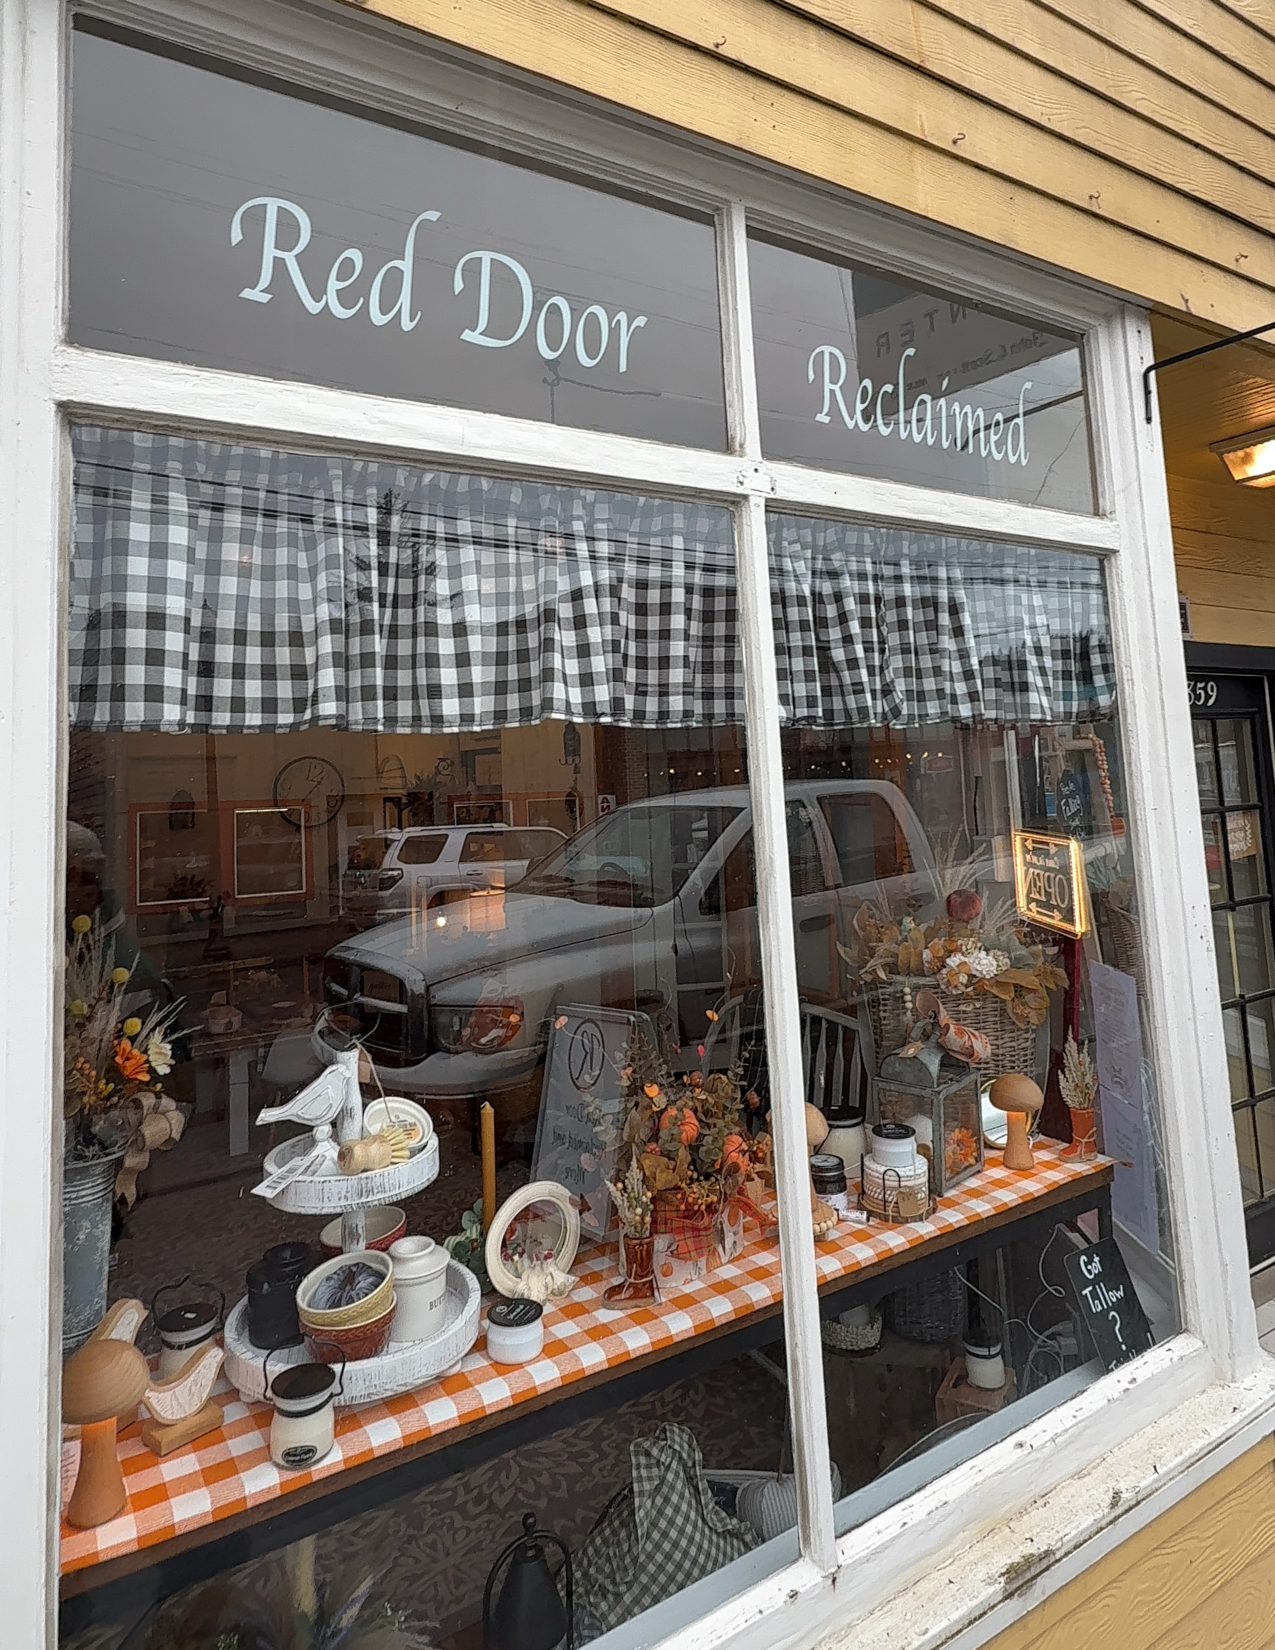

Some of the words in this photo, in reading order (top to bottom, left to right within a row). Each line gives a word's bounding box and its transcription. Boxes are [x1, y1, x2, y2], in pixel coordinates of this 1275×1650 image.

[229, 196, 441, 332] Red
[453, 250, 648, 374] Door
[807, 344, 1033, 467] Reclaimed
[1079, 1254, 1103, 1280] Got
[1081, 1282, 1125, 1314] Tallow
[1108, 1310, 1127, 1351] ?
